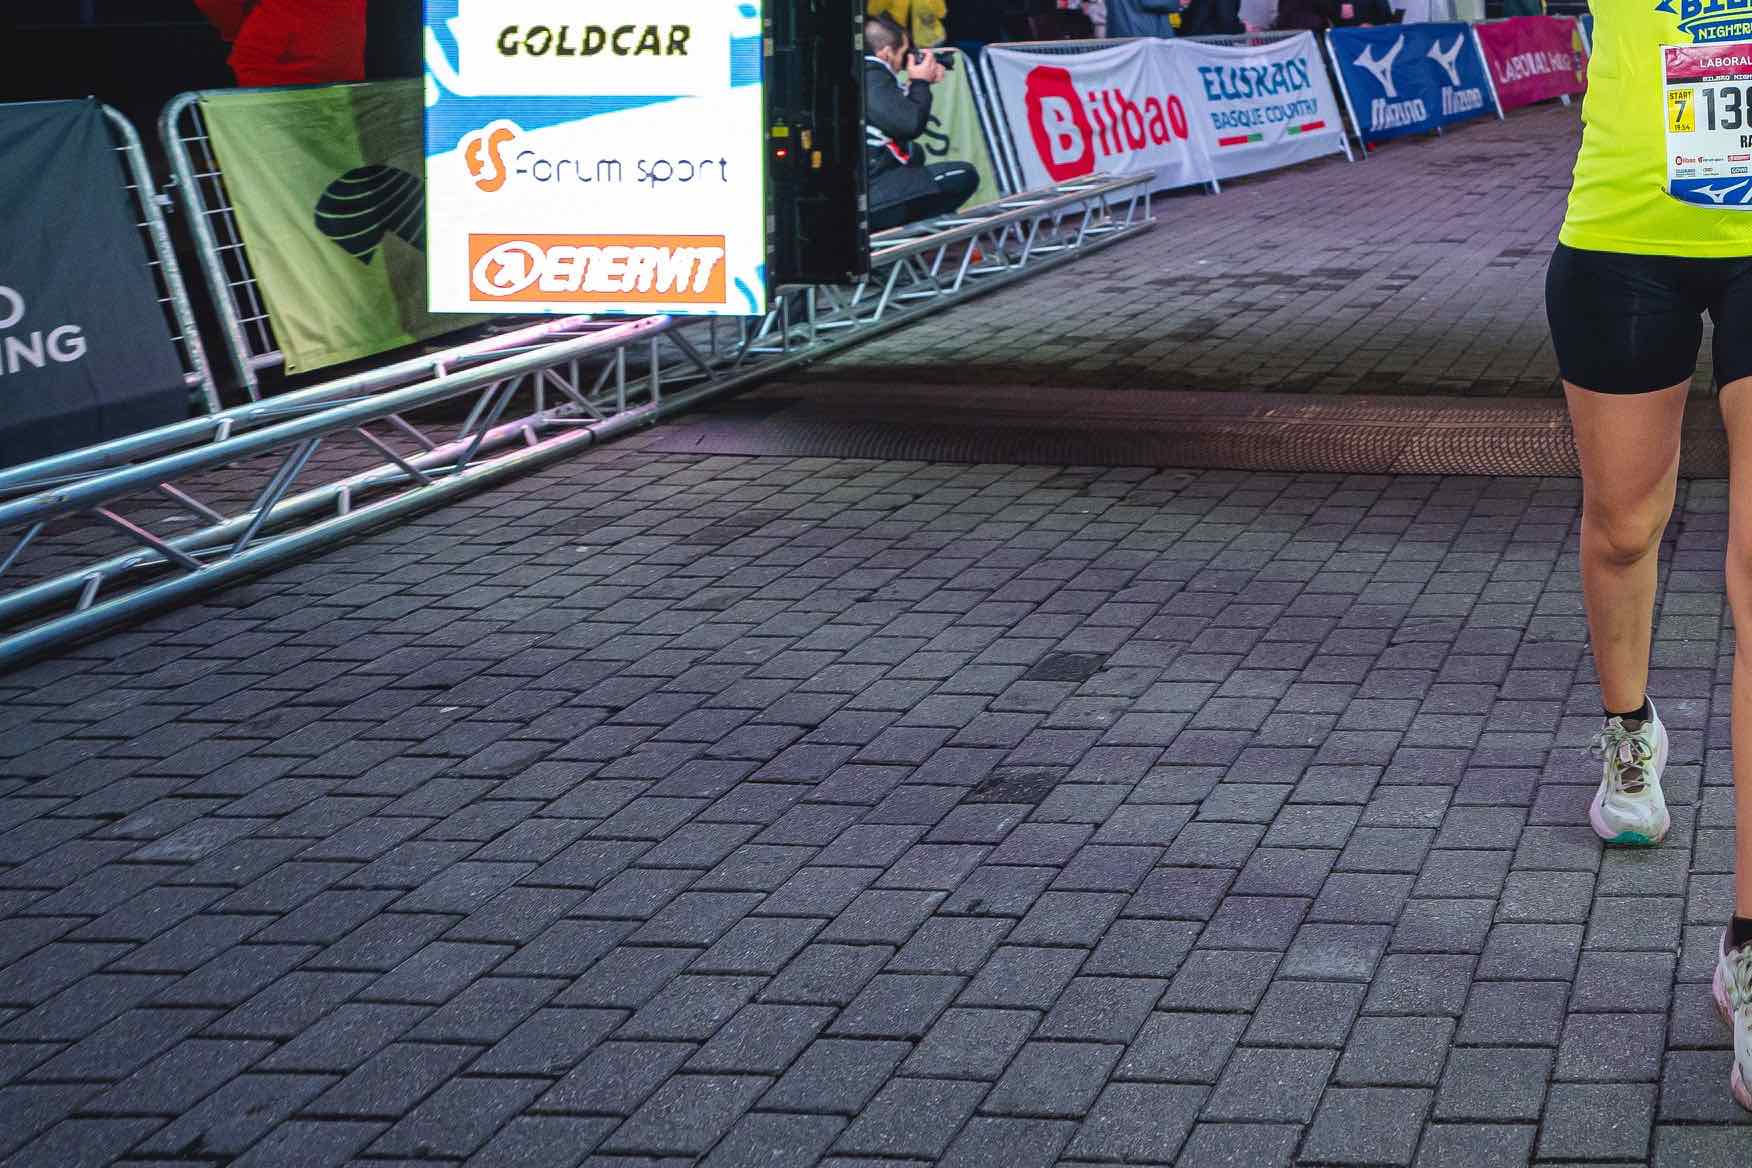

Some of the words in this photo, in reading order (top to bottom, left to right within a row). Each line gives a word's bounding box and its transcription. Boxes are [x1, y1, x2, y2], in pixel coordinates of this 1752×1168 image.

[497, 25, 691, 57] GOLDCAR
[1198, 58, 1312, 101] EUSKADI
[1669, 91, 1692, 99] START
[1040, 88, 1189, 165] Bilbao
[1211, 107, 1263, 130] BASQUE
[1265, 98, 1318, 124] COUNTRY
[1674, 100, 1687, 123] 7
